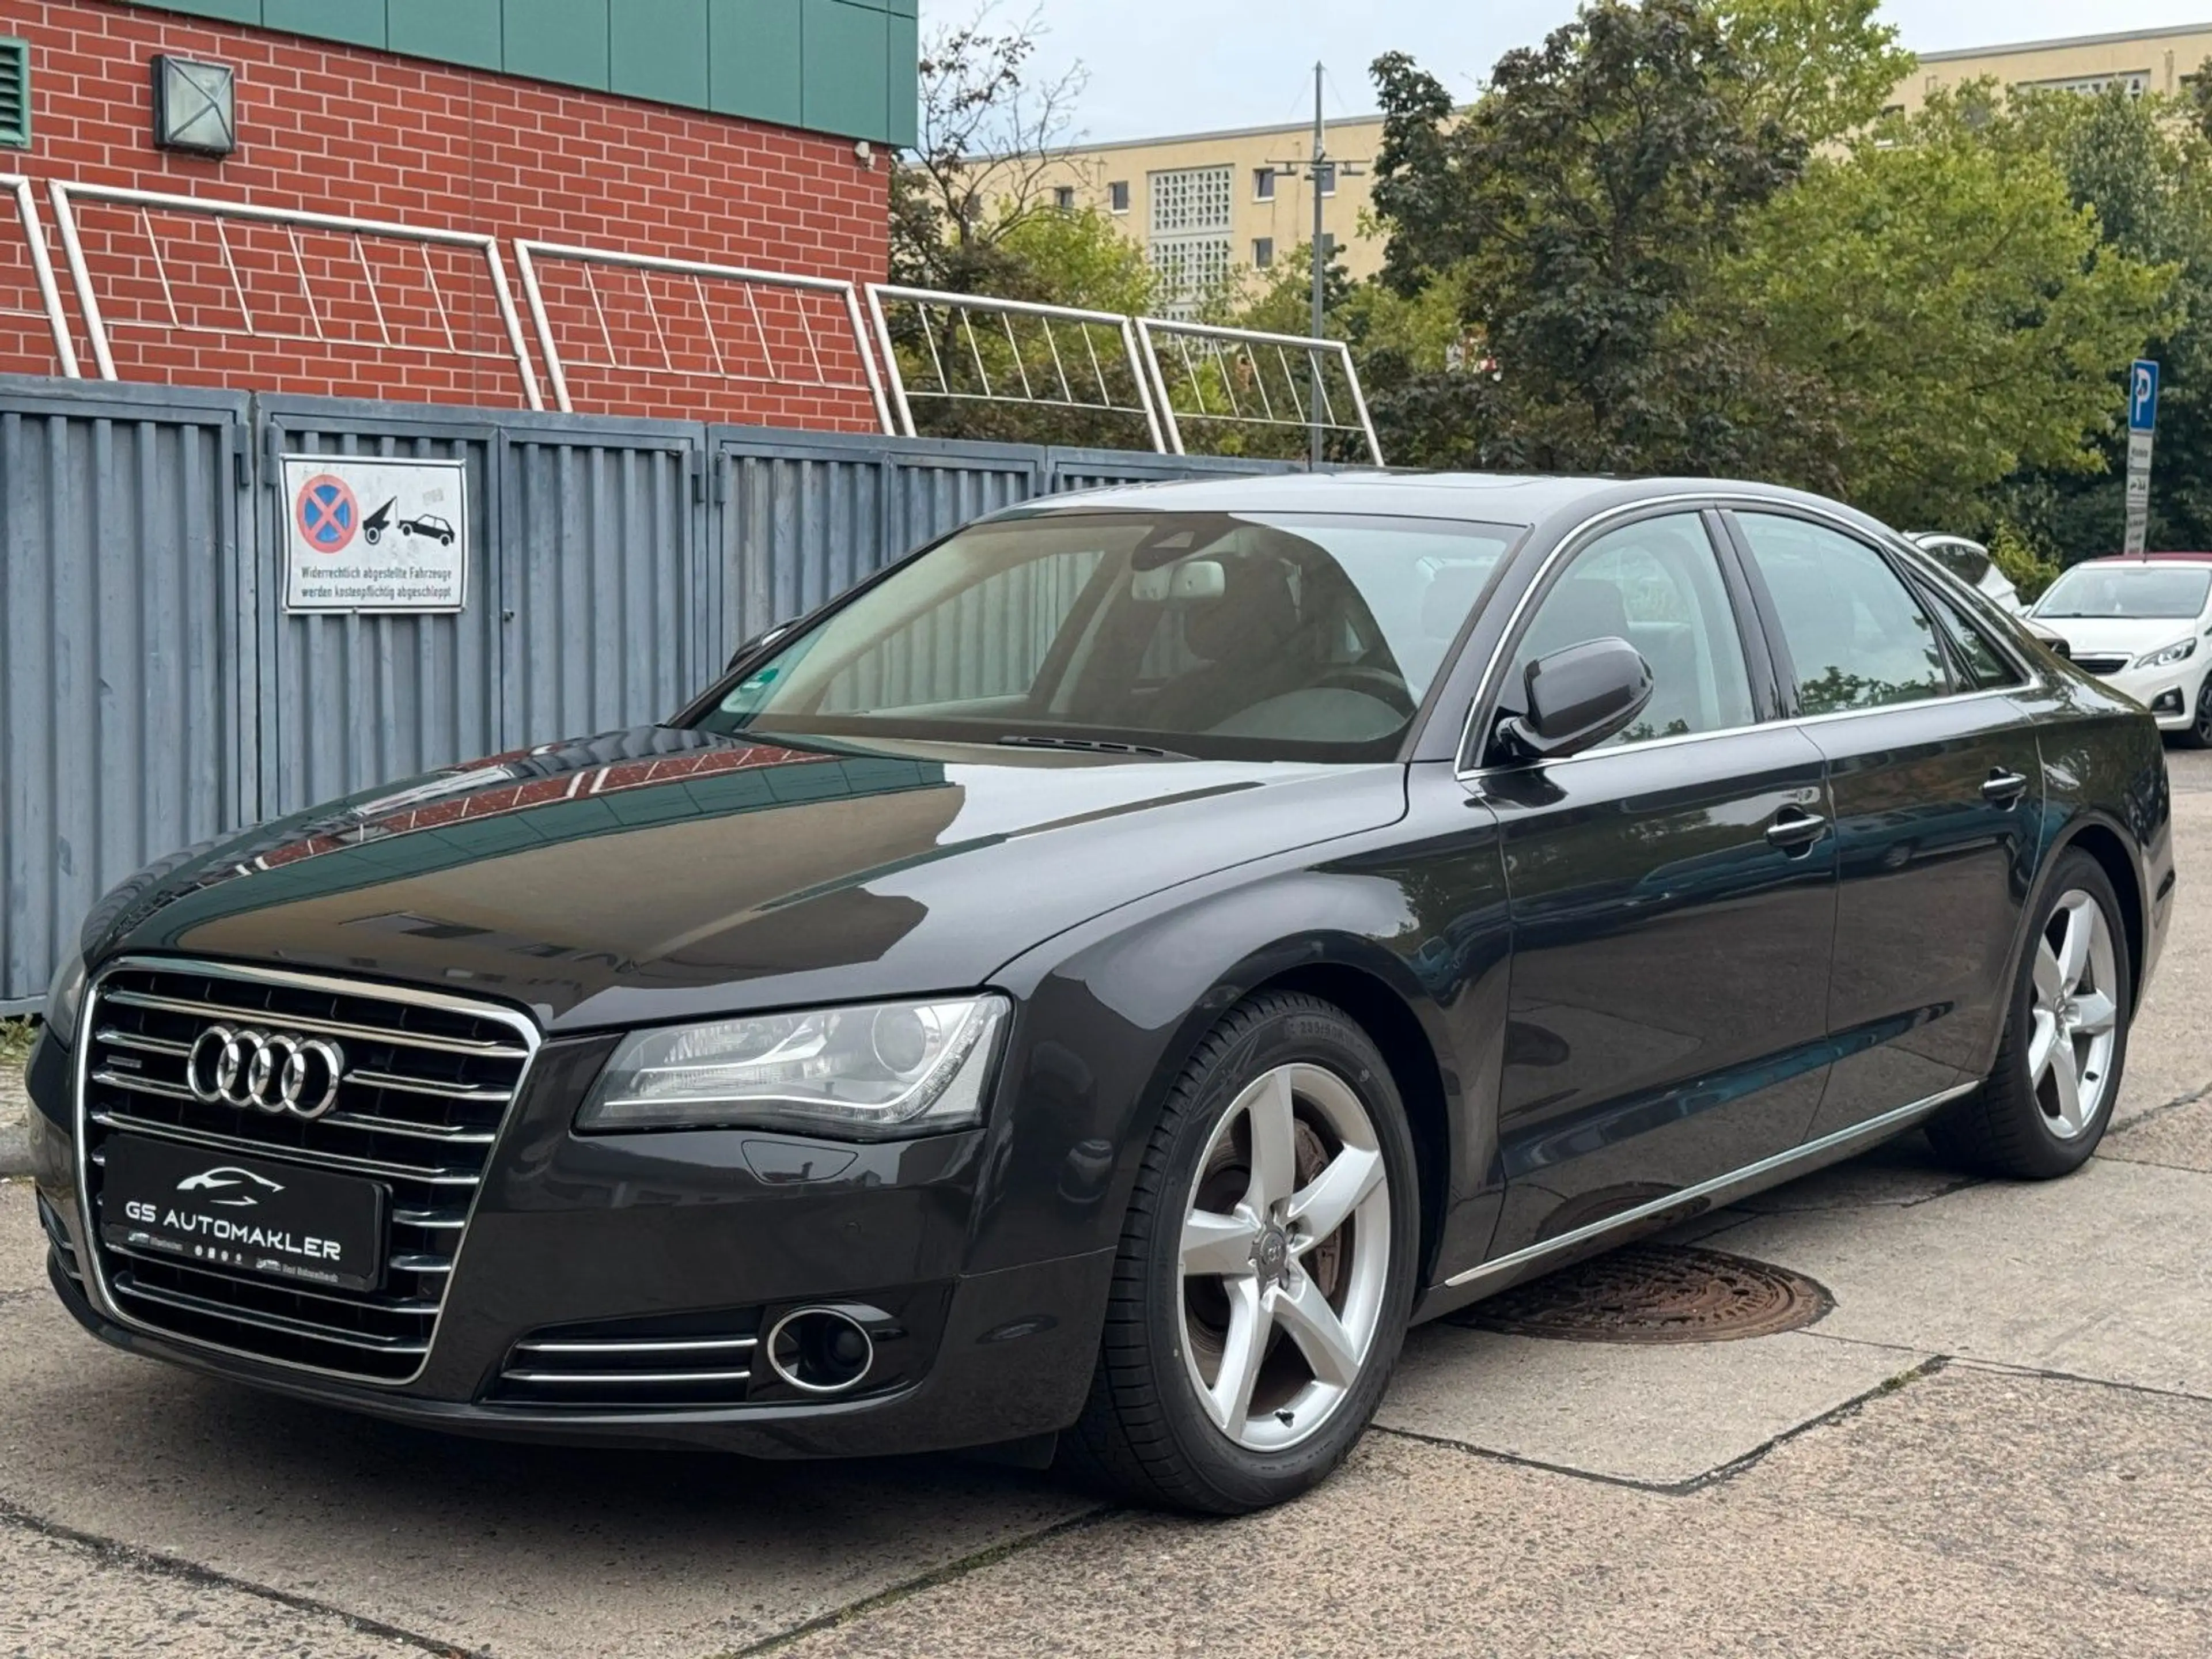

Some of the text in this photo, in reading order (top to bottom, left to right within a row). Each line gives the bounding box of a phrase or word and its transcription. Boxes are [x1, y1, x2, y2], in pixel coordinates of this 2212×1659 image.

[2135, 367, 2152, 422] P
[301, 565, 452, 582] Widerrechtlich abgestellte Fahrzeuge
[301, 585, 452, 601] werden kostenpflichtig abgeschleppt
[125, 1200, 342, 1261] GS AUTOMAKLER
